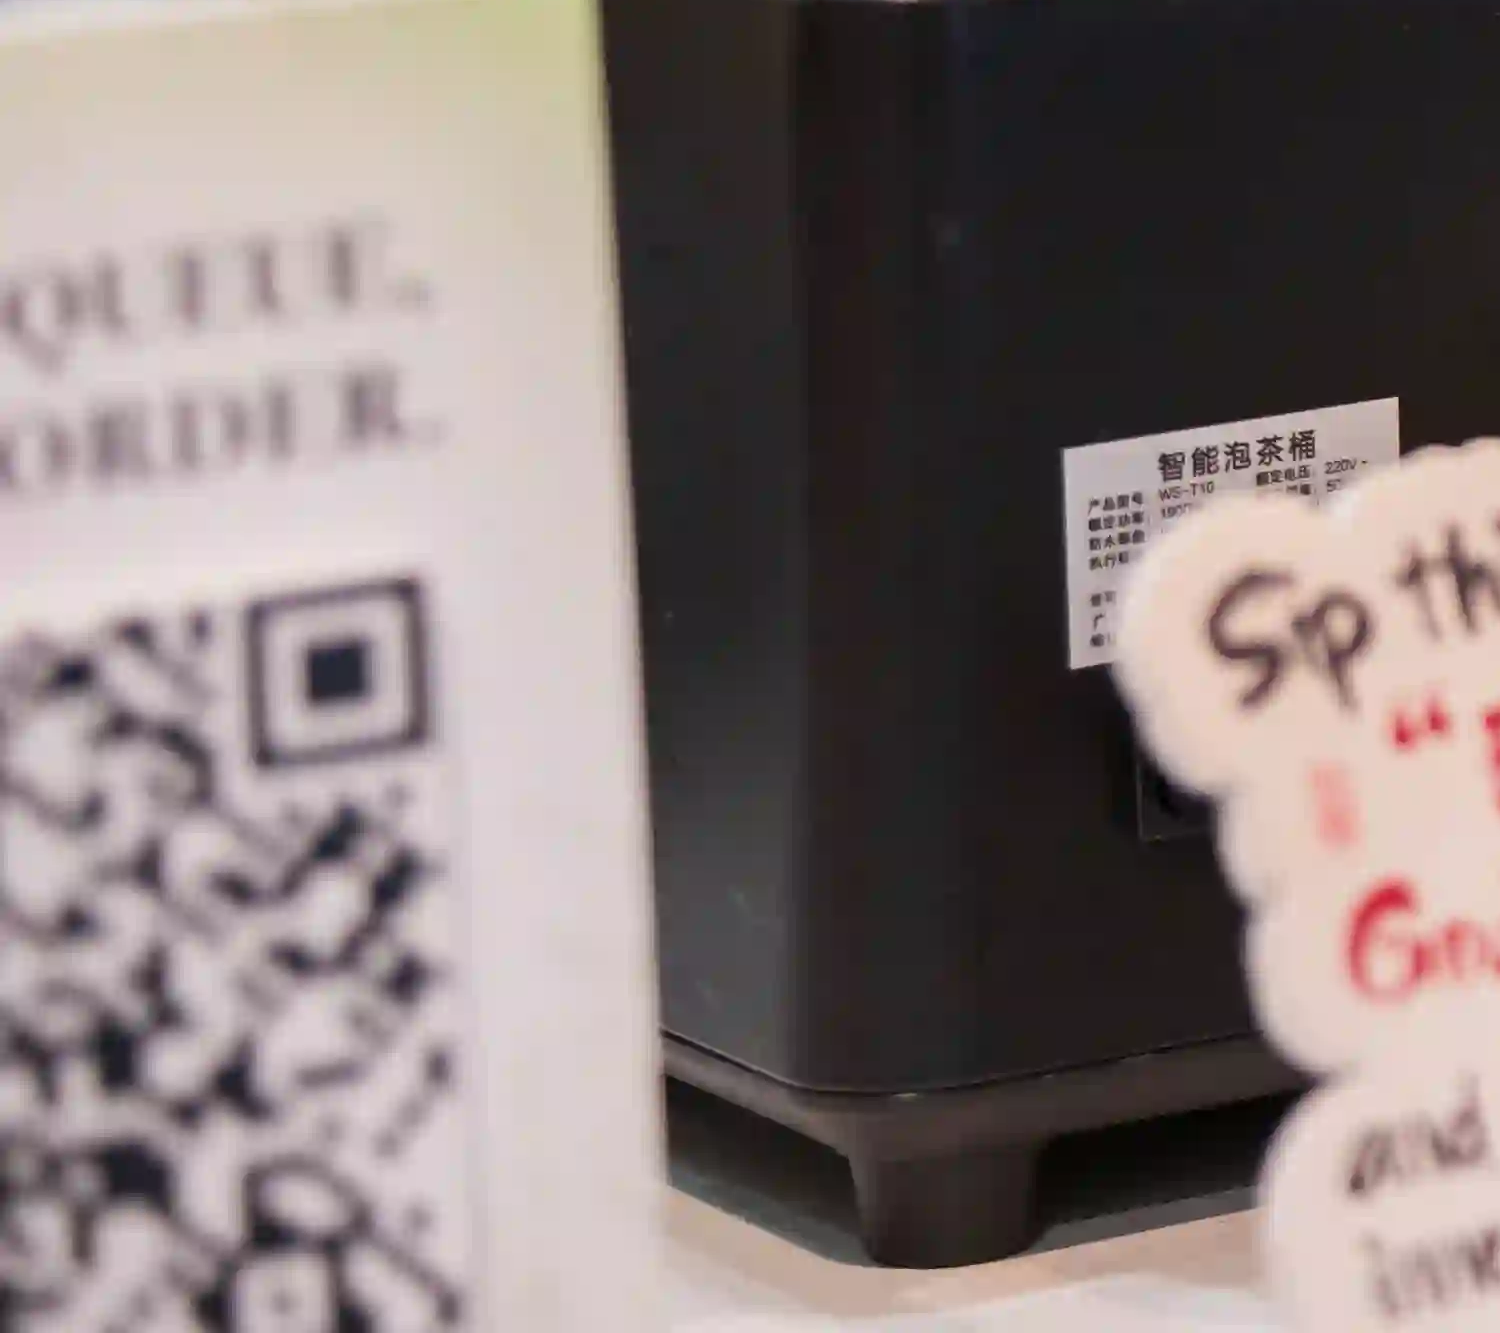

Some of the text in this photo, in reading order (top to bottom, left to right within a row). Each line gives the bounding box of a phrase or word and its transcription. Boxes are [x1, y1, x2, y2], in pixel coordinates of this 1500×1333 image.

[1157, 429, 1316, 482] 智能泡茶桶
[1347, 1073, 1490, 1203] and
